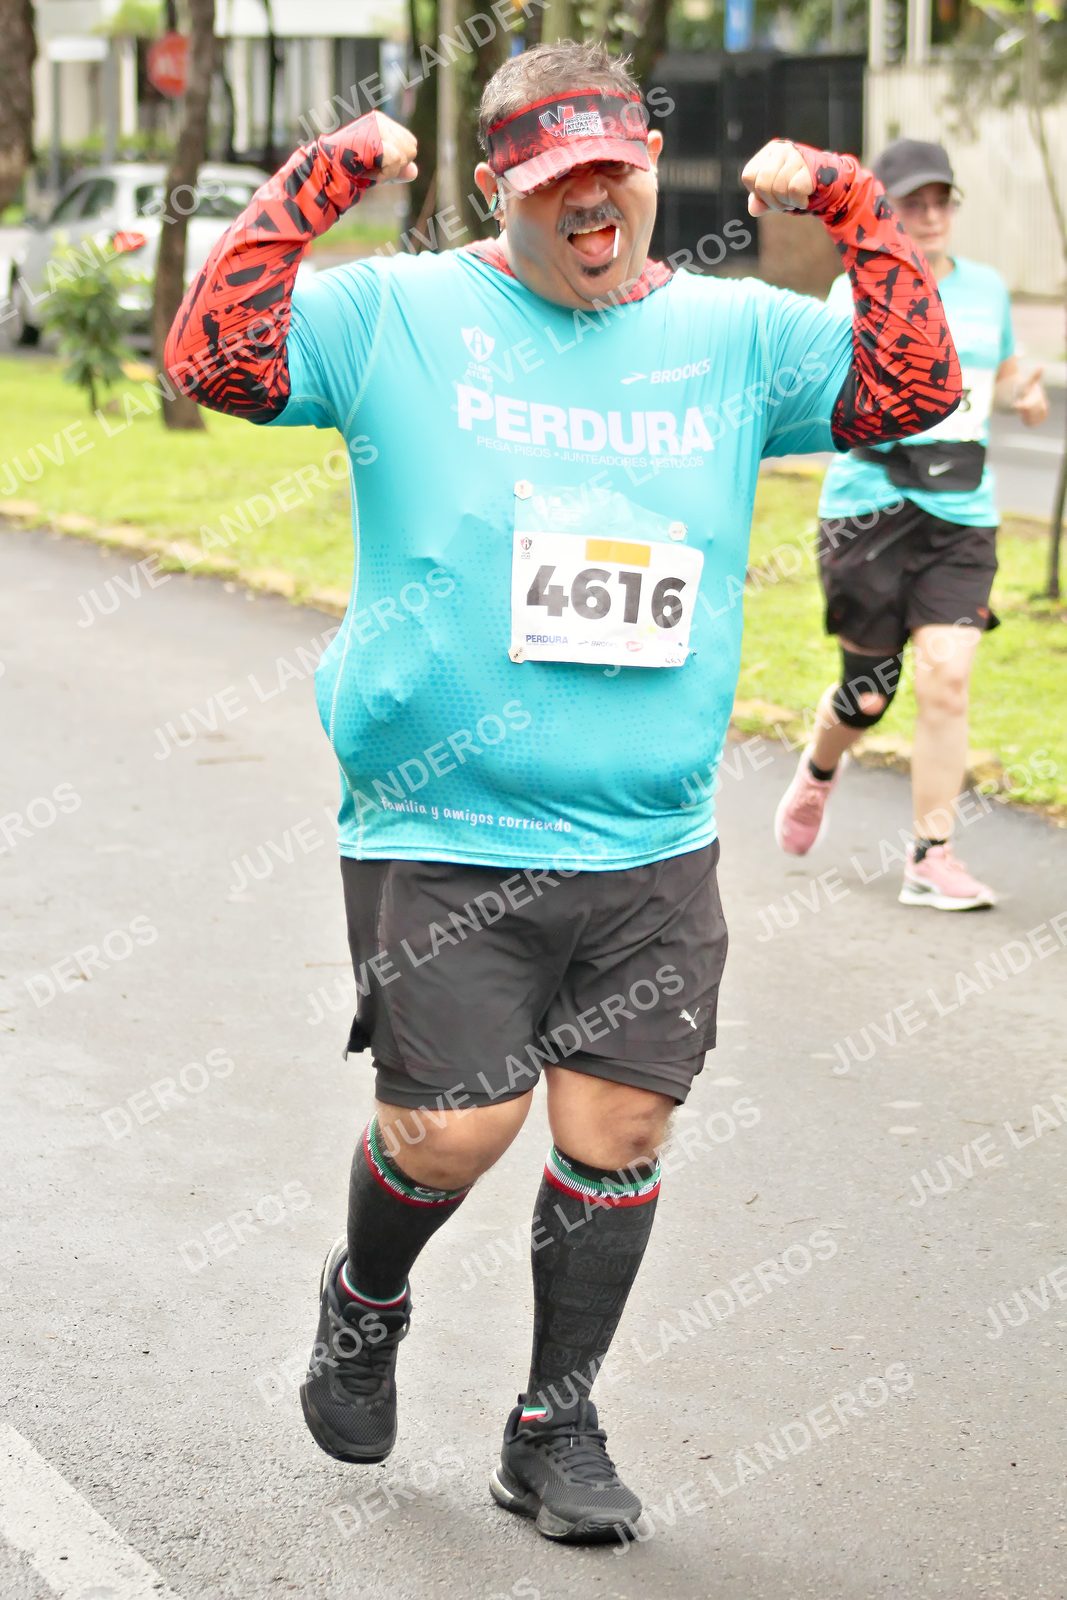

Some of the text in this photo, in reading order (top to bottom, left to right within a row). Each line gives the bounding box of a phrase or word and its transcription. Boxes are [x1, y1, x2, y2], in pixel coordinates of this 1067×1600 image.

[650, 358, 711, 384] BROOKS
[456, 383, 715, 456] PERDURA
[476, 435, 704, 469] PEGA PISOS JUNTEADORES ESTUCOS
[526, 565, 686, 629] 4616
[526, 634, 569, 645] PERDURA
[590, 639, 618, 647] BRO
[381, 796, 572, 833] familia y amigos corriendo
